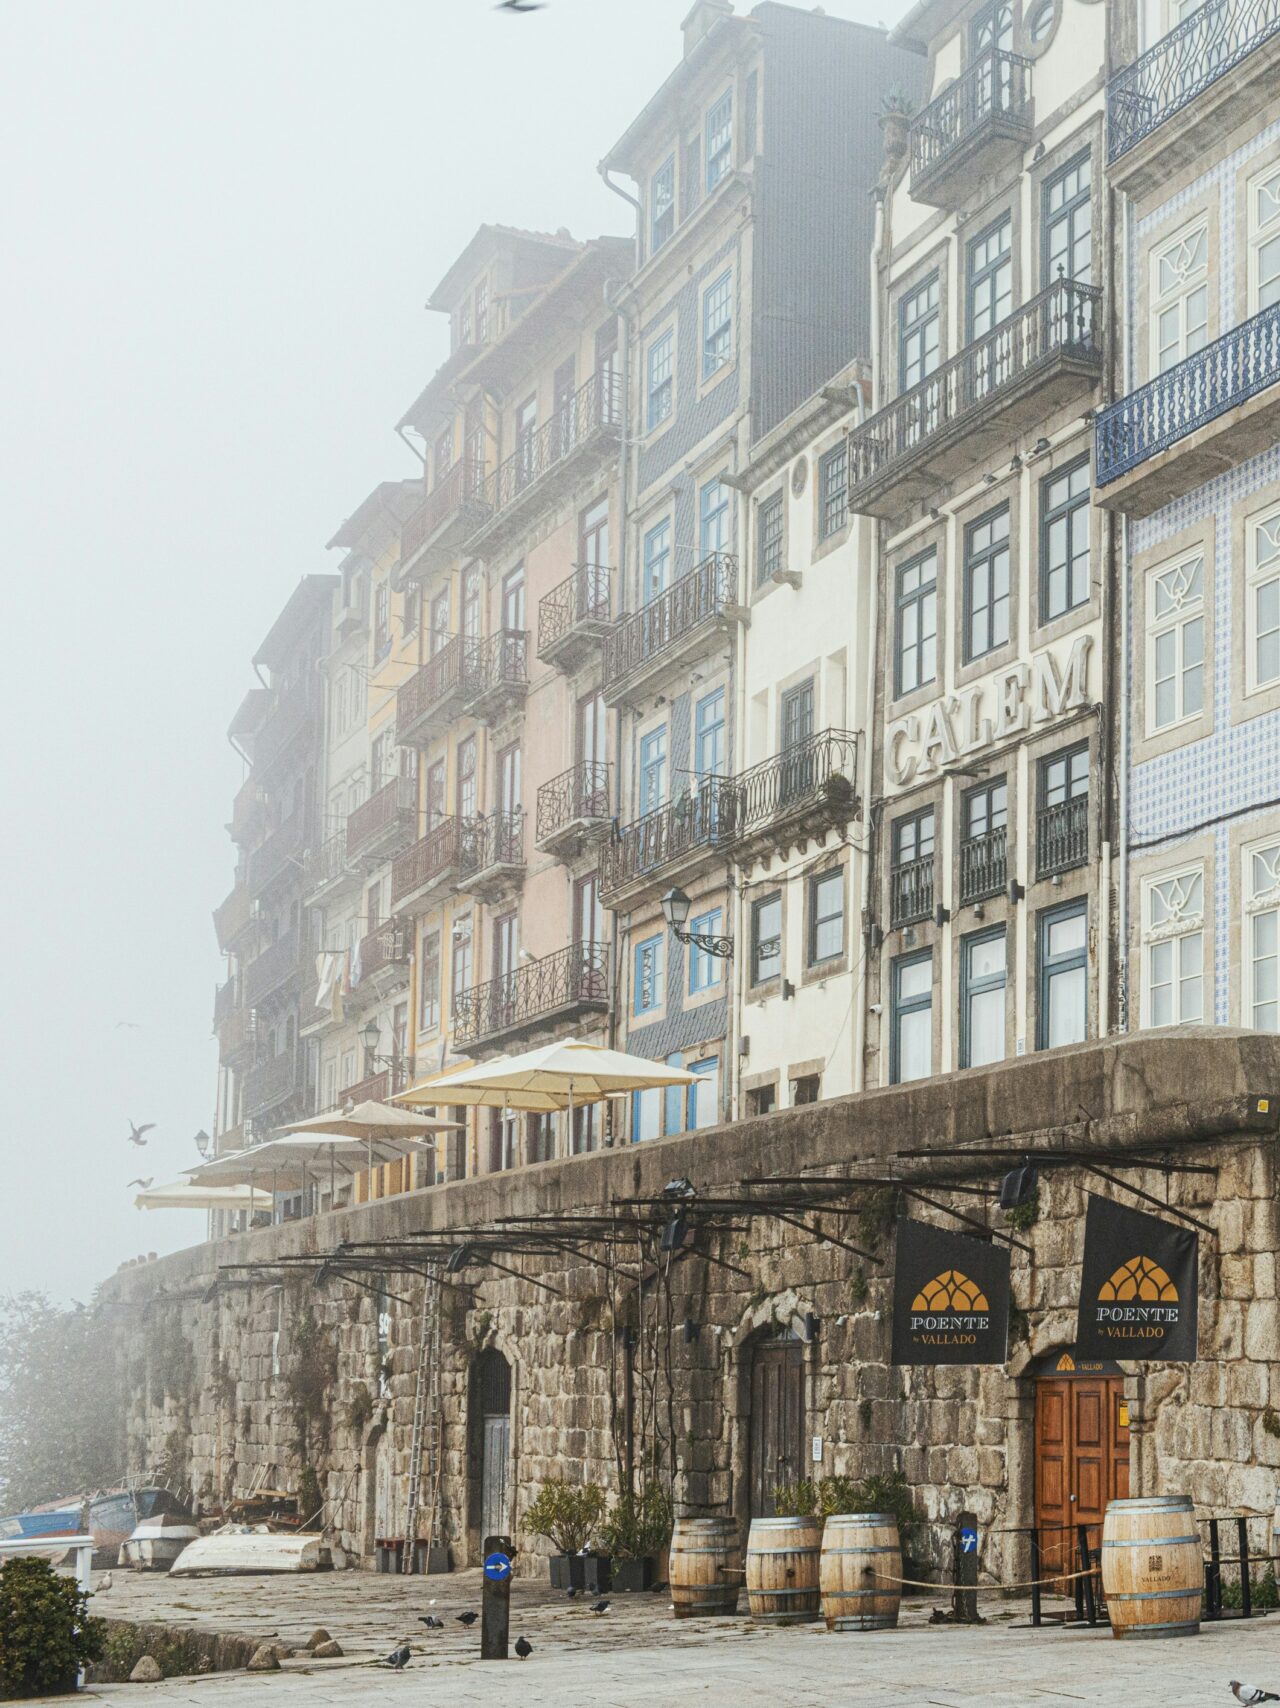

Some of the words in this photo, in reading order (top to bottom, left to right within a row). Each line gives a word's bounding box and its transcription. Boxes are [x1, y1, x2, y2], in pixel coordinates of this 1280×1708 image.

[1096, 1307, 1178, 1322] POENTE
[910, 1316, 989, 1330] POENTE
[1107, 1326, 1165, 1338] VALLADO
[921, 1334, 977, 1345] VALLADO
